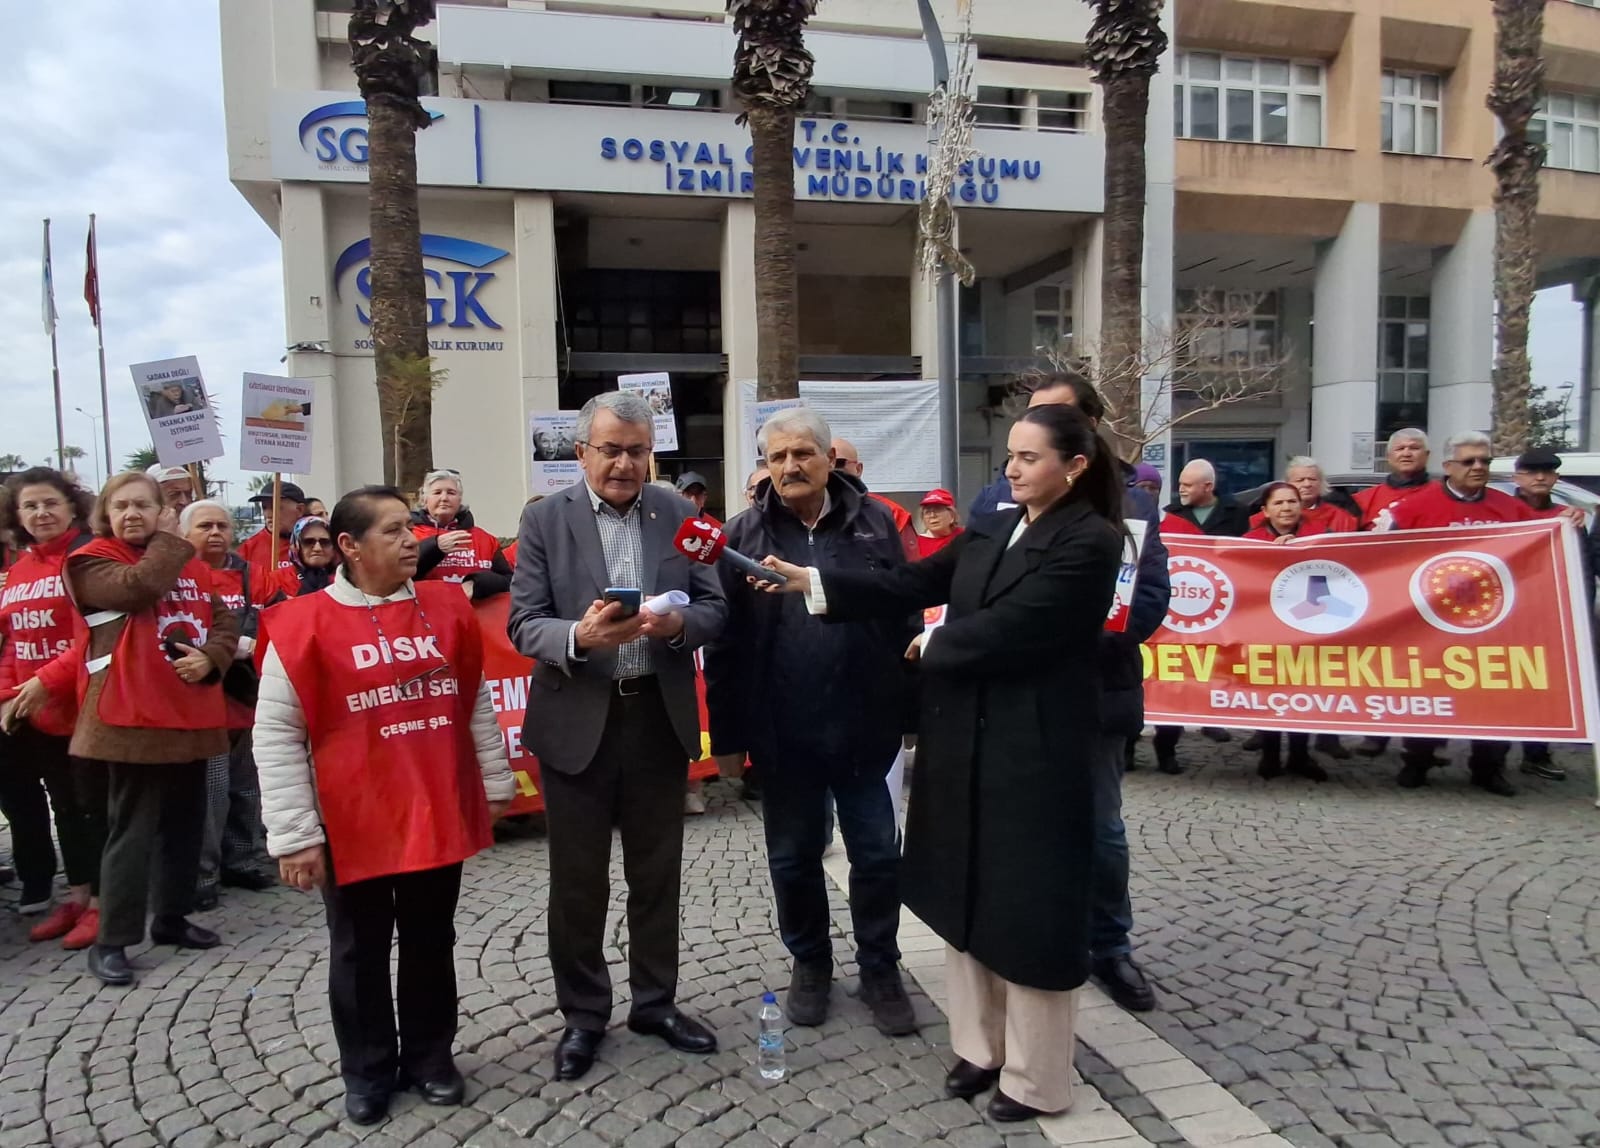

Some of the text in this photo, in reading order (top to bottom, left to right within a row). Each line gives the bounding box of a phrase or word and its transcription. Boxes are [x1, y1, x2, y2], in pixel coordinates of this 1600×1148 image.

[316, 126, 369, 164] SG
[801, 121, 860, 144] T.C.
[601, 137, 732, 165] SOSYAL
[746, 146, 904, 174] VENLİK
[666, 162, 754, 193] İZMİR
[456, 341, 503, 351] KURUMU
[1170, 581, 1211, 600] DİSK
[11, 607, 57, 630] DİSK
[351, 635, 444, 670] DİSK
[1139, 643, 1218, 682] DEV
[429, 678, 459, 697] SEN
[1210, 689, 1454, 720] BALÇOVA ŞUBE
[380, 715, 452, 739] ÇEŞME ŞB.
